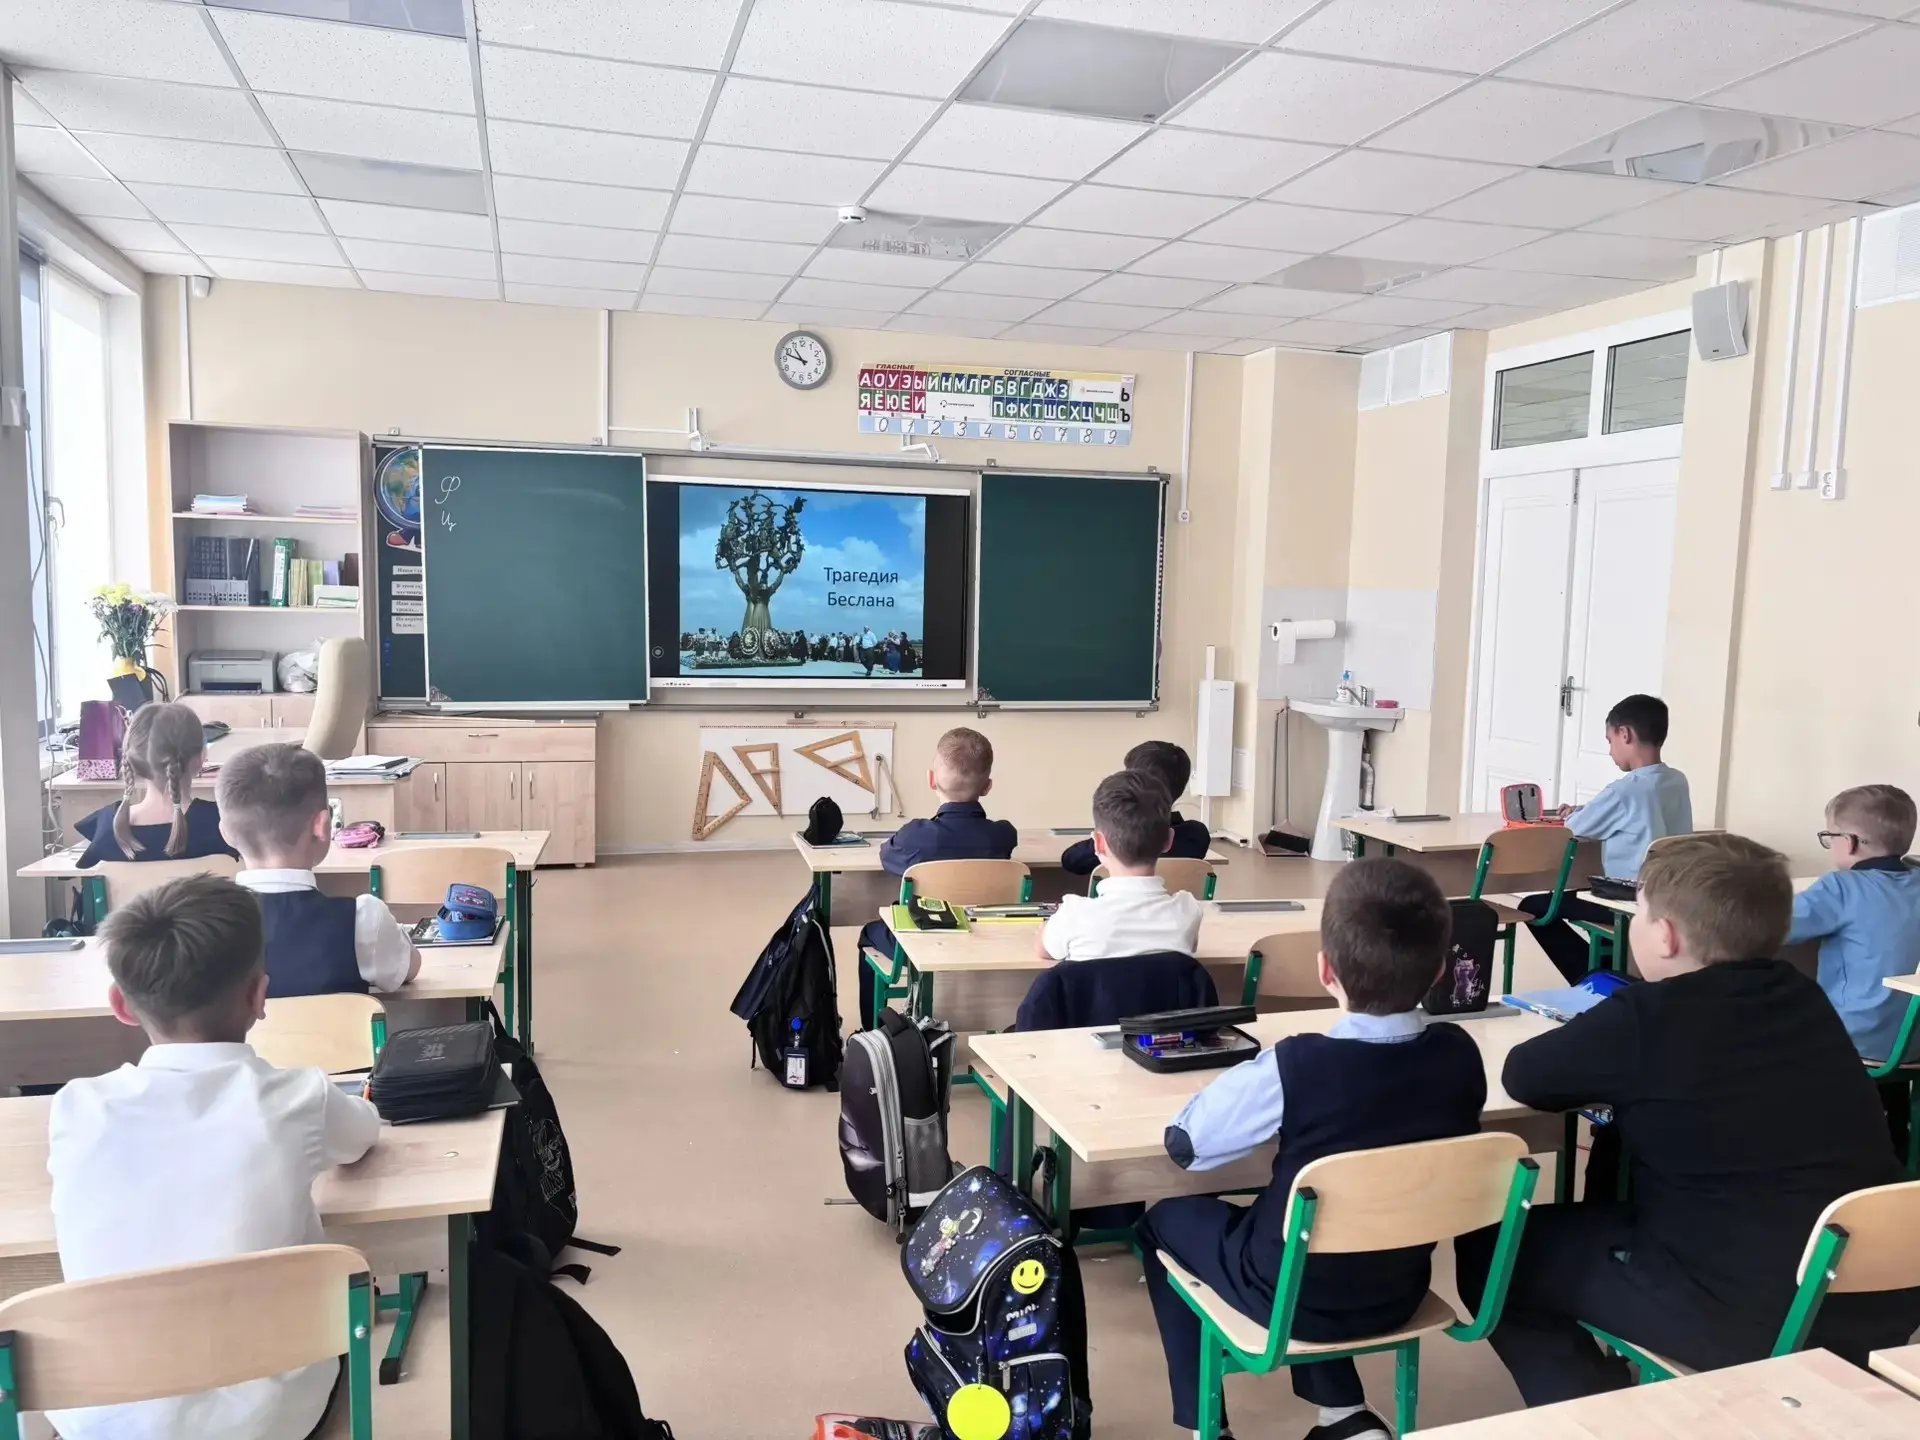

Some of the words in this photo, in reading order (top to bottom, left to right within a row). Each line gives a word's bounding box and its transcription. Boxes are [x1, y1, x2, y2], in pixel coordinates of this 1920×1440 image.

[799, 340, 806, 348] 12
[1004, 369, 1051, 377] СОГЛАСНЫЕ
[879, 417, 889, 432] 0
[908, 419, 915, 433] 1
[931, 420, 942, 436] 2
[957, 422, 967, 437] 3
[984, 423, 993, 438] 4
[1007, 424, 1017, 439] 5
[1033, 426, 1043, 440] 6
[1059, 427, 1068, 442] 7
[1083, 428, 1093, 443] 8
[1108, 429, 1117, 444] 9
[823, 567, 899, 585] Трагедия
[828, 592, 895, 607] Беслана
